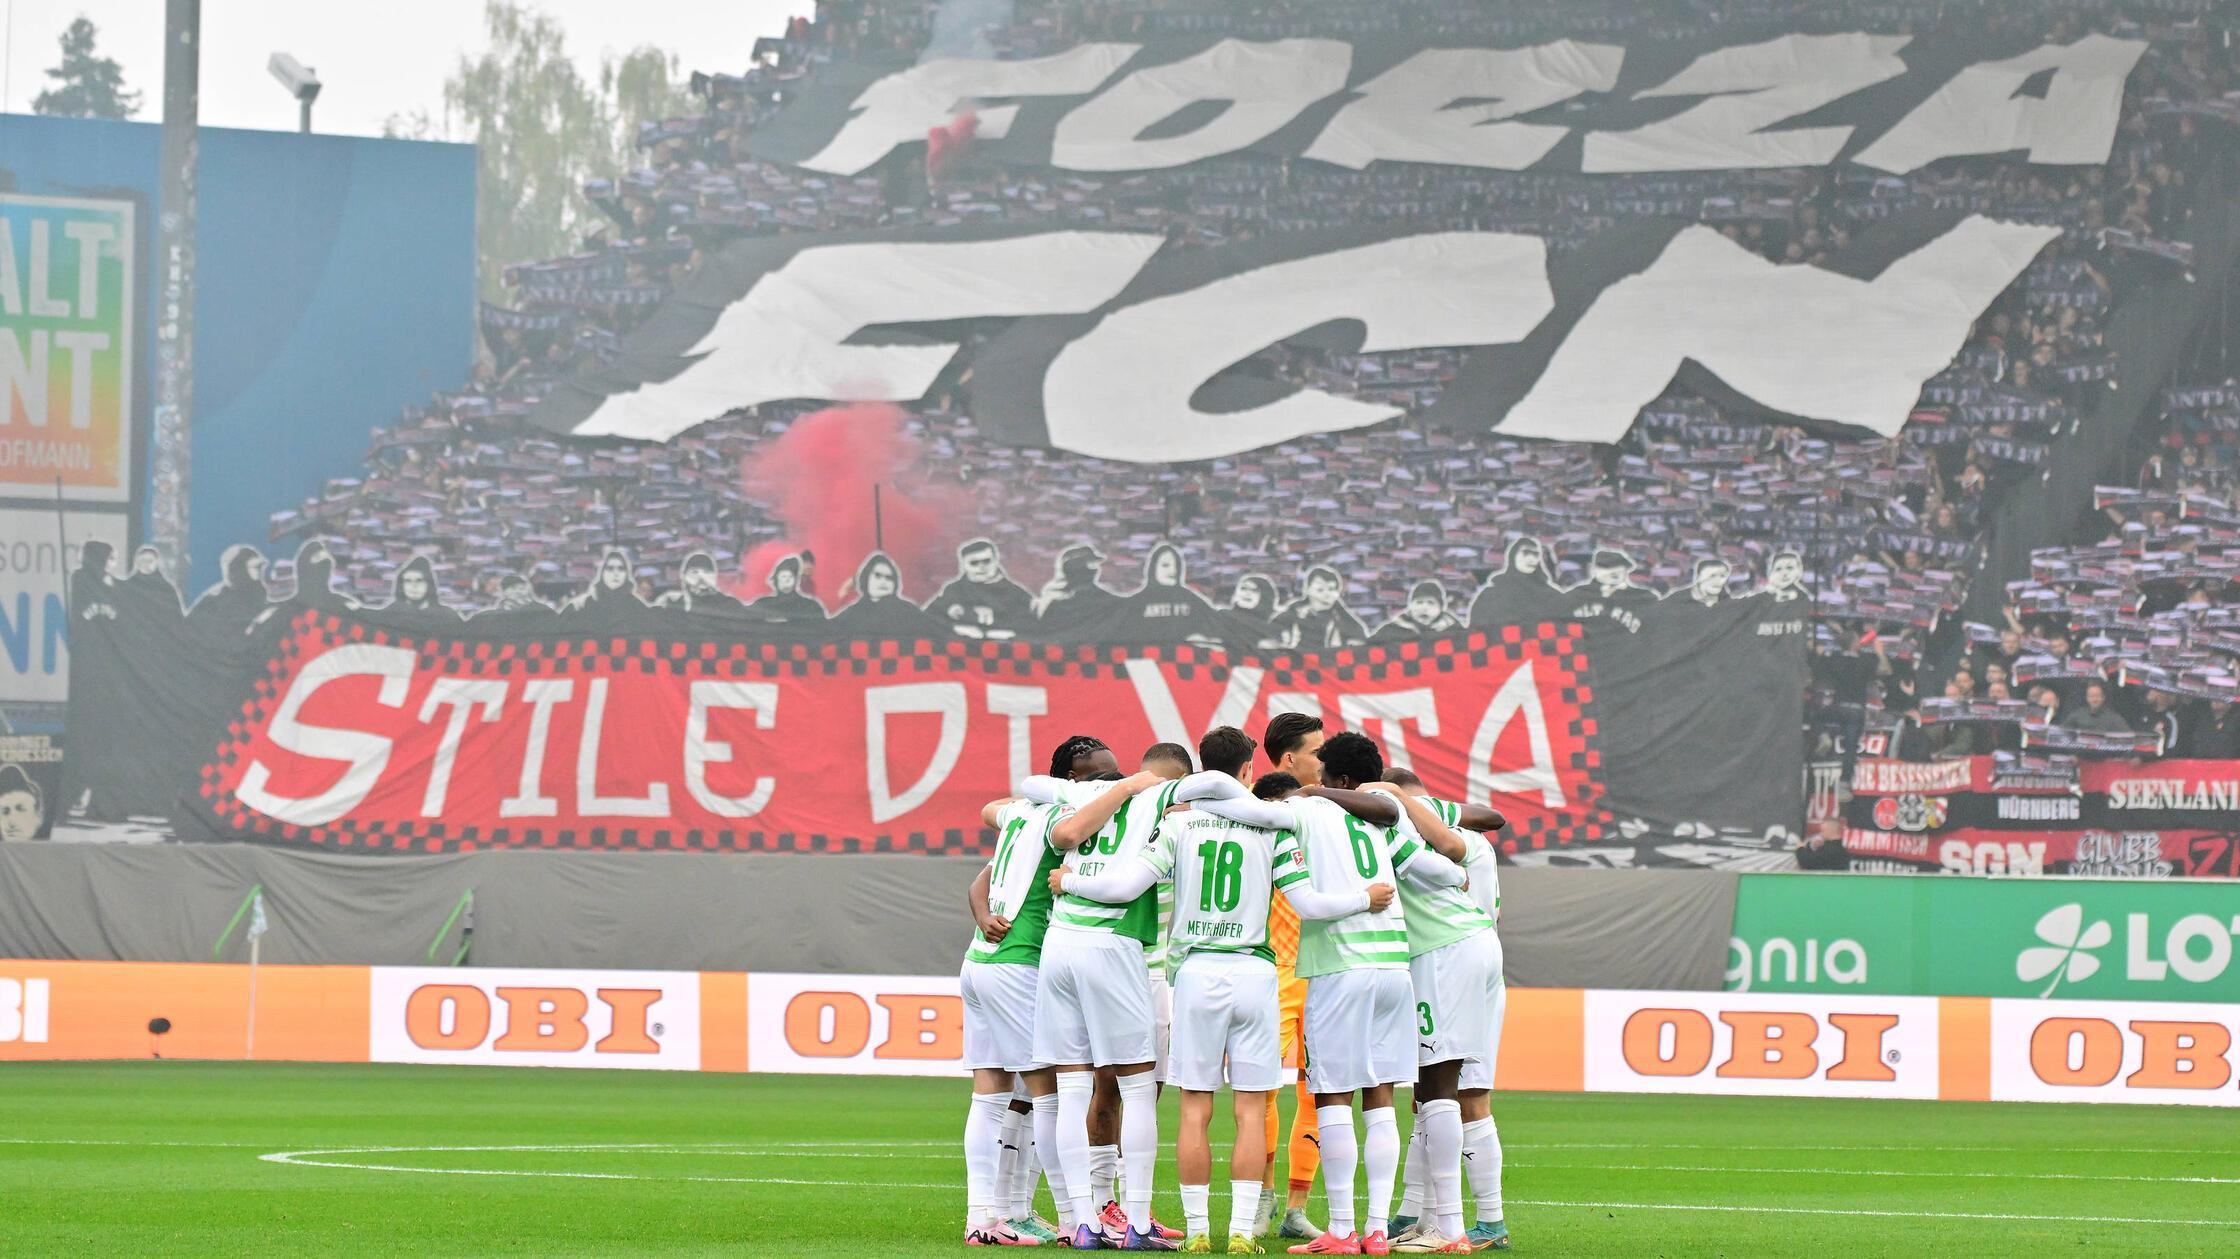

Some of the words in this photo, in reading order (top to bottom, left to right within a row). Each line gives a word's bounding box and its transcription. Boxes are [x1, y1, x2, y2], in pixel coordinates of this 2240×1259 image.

[797, 33, 2148, 174] FORZA
[572, 217, 2061, 462] FCN
[235, 643, 779, 826] STILE
[865, 681, 1048, 824] DI
[1125, 659, 1567, 809] VTA
[1187, 818, 1210, 830] SPVGG
[1998, 795, 2080, 820] NÜRNBERG
[991, 816, 1028, 888] 11
[1198, 839, 1244, 913] 18
[1344, 813, 1379, 880] 6
[2127, 913, 2240, 983] LO
[405, 983, 664, 1055] OBI
[1621, 1007, 1899, 1082] OBI
[2030, 1016, 2240, 1090] OB
